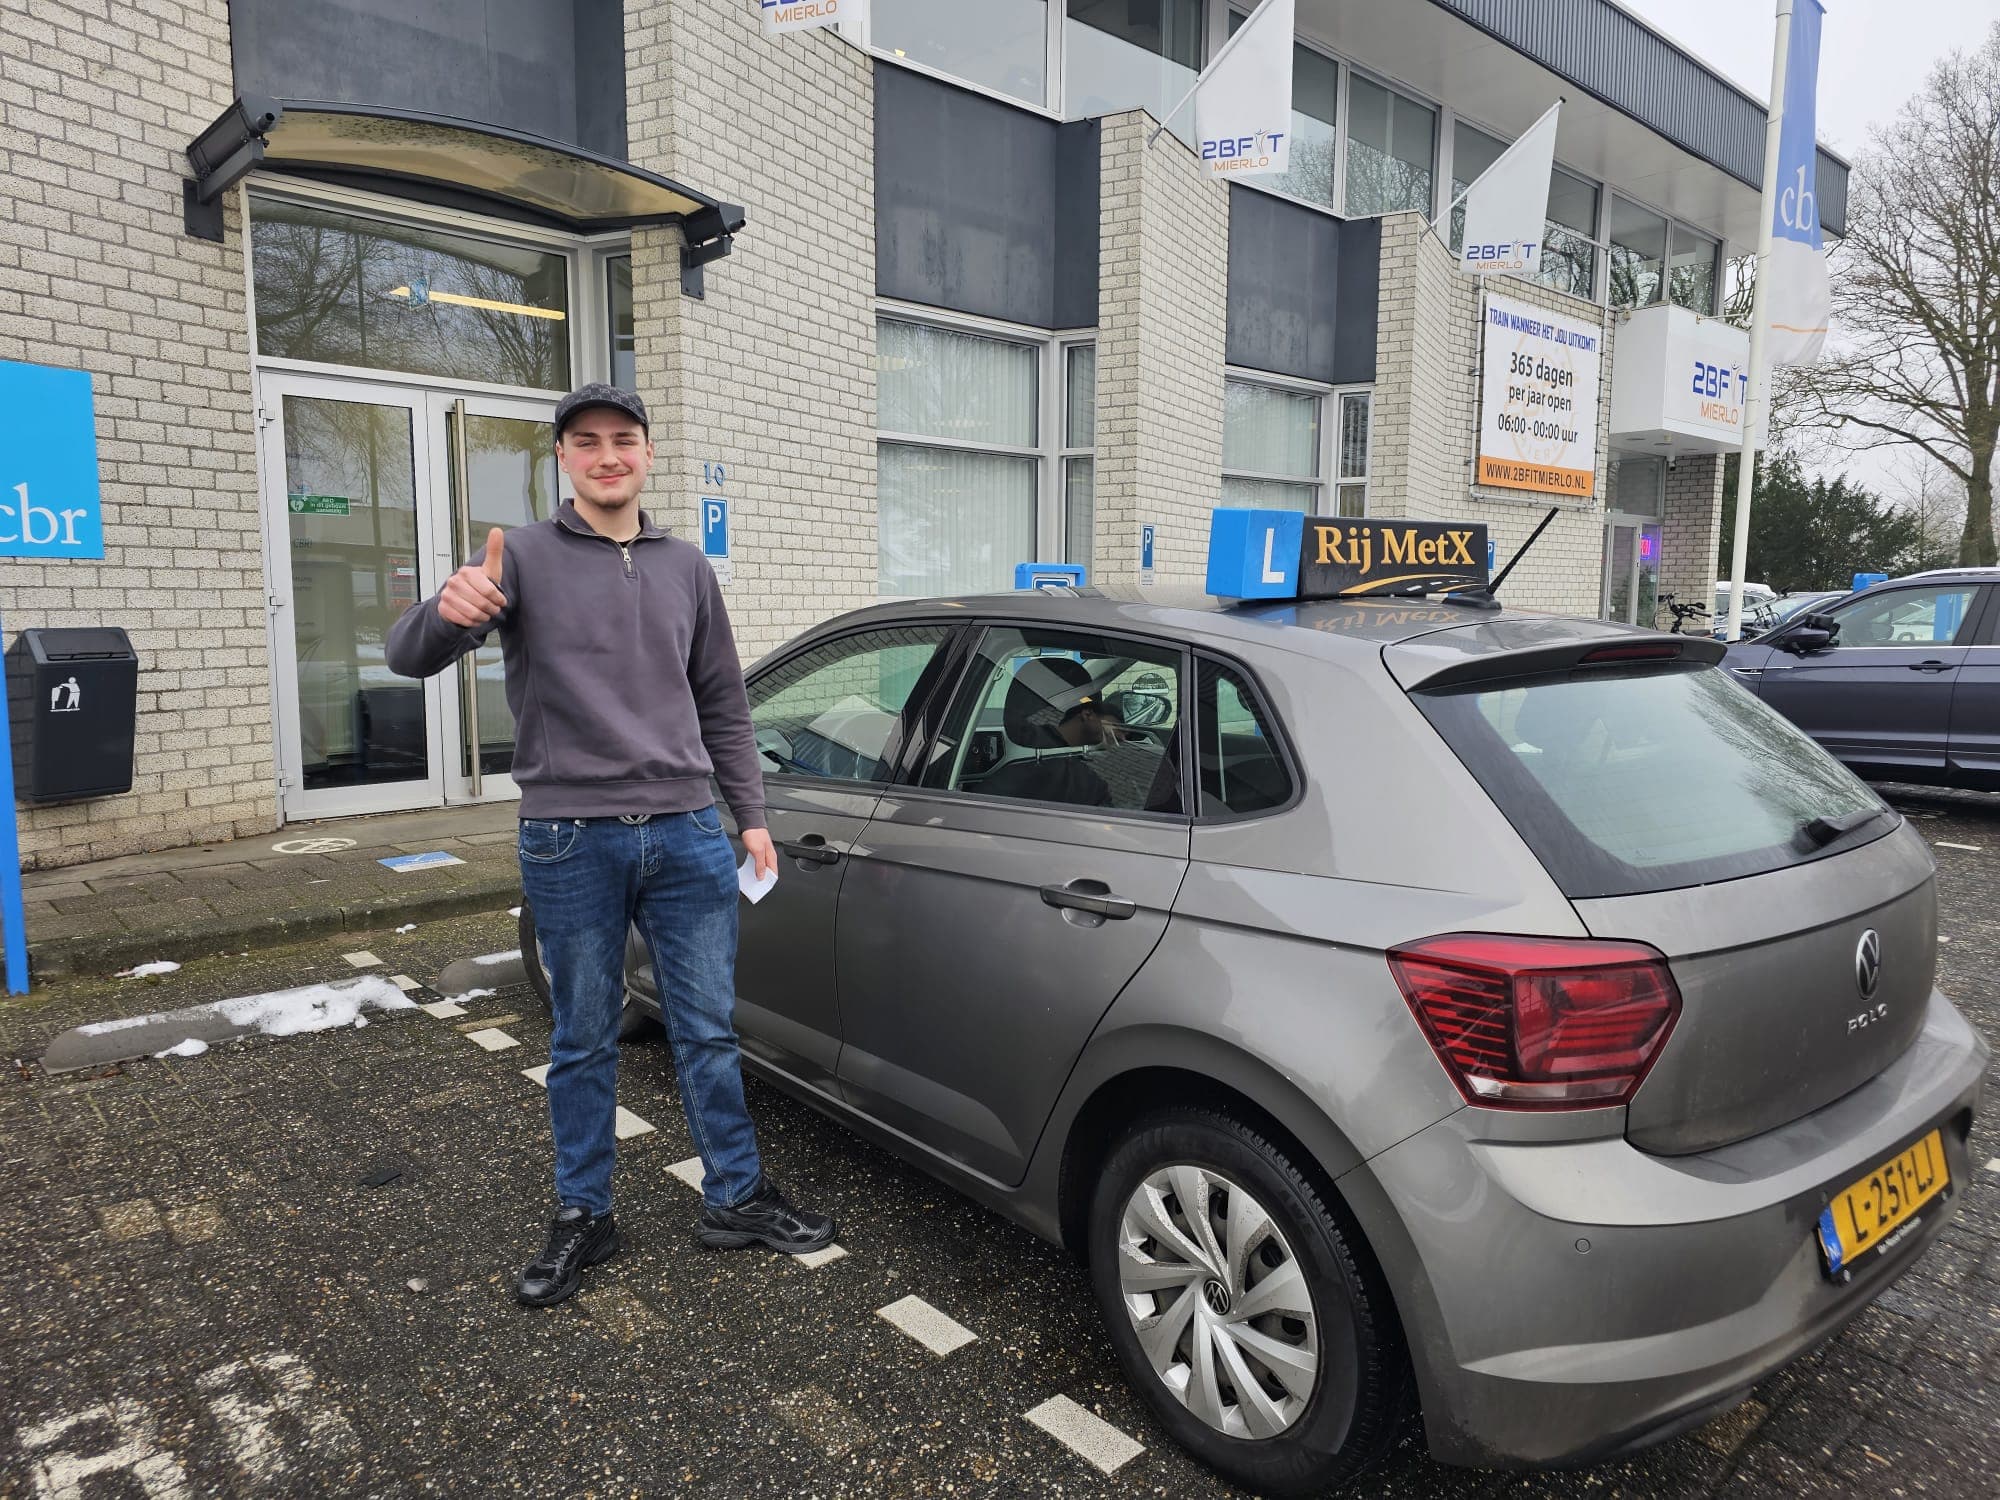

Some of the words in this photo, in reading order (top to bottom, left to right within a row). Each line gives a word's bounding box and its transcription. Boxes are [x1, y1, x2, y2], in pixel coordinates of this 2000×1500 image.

[774, 0, 838, 23] MIERLO
[1214, 157, 1269, 171] MIERLO
[1781, 164, 1814, 232] cb
[1475, 260, 1523, 270] MIERLO
[1489, 308, 1510, 329] TRAIN
[1510, 314, 1541, 338] WANNEER
[1541, 324, 1555, 342] HET
[1554, 328, 1568, 345] JOU
[1510, 352, 1534, 378] 365
[1536, 358, 1574, 389] dagen
[1509, 385, 1526, 404] per
[1526, 385, 1547, 408] jaar
[1547, 395, 1572, 413] open
[1700, 401, 1739, 425] MIERLO
[1498, 413, 1526, 434] 06:00
[1533, 420, 1560, 441] 00:00
[1561, 429, 1579, 444] uur
[703, 462, 725, 488] 10
[1485, 462, 1587, 490] WWW.2BFITMIERLO.NL
[707, 504, 722, 534] P
[1144, 529, 1152, 552] P
[1261, 528, 1285, 584] L
[1314, 525, 1371, 575] Rij
[1380, 528, 1476, 565] MetX
[1847, 1003, 1888, 1035] POLO
